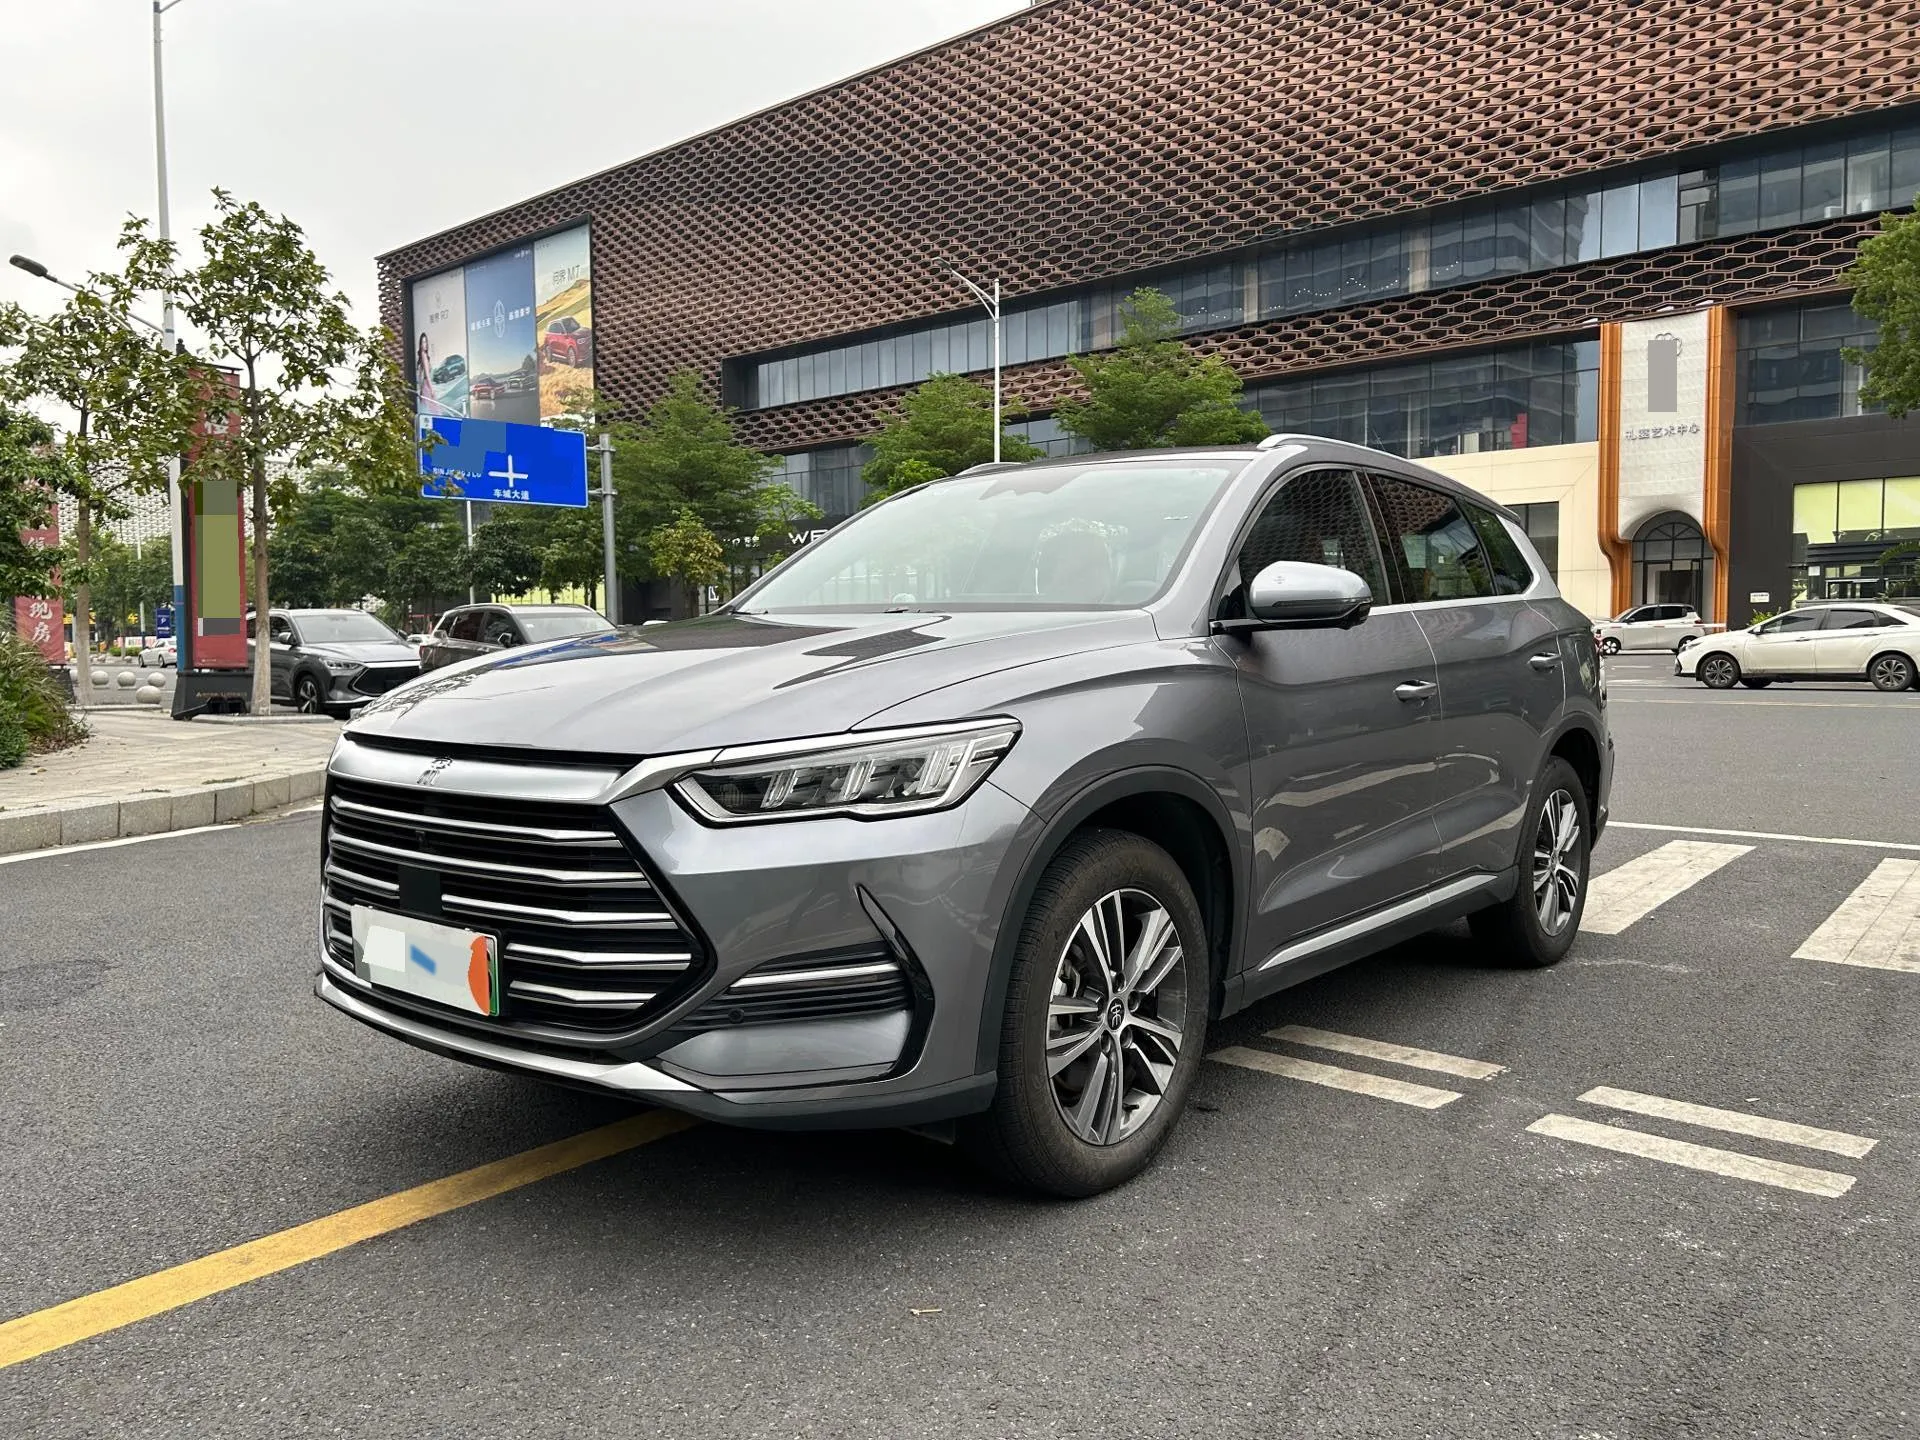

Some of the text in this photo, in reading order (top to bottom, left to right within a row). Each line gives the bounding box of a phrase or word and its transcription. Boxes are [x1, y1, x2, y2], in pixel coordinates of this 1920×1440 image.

[493, 488, 530, 500] 车城大道
[29, 597, 53, 643] 现房
